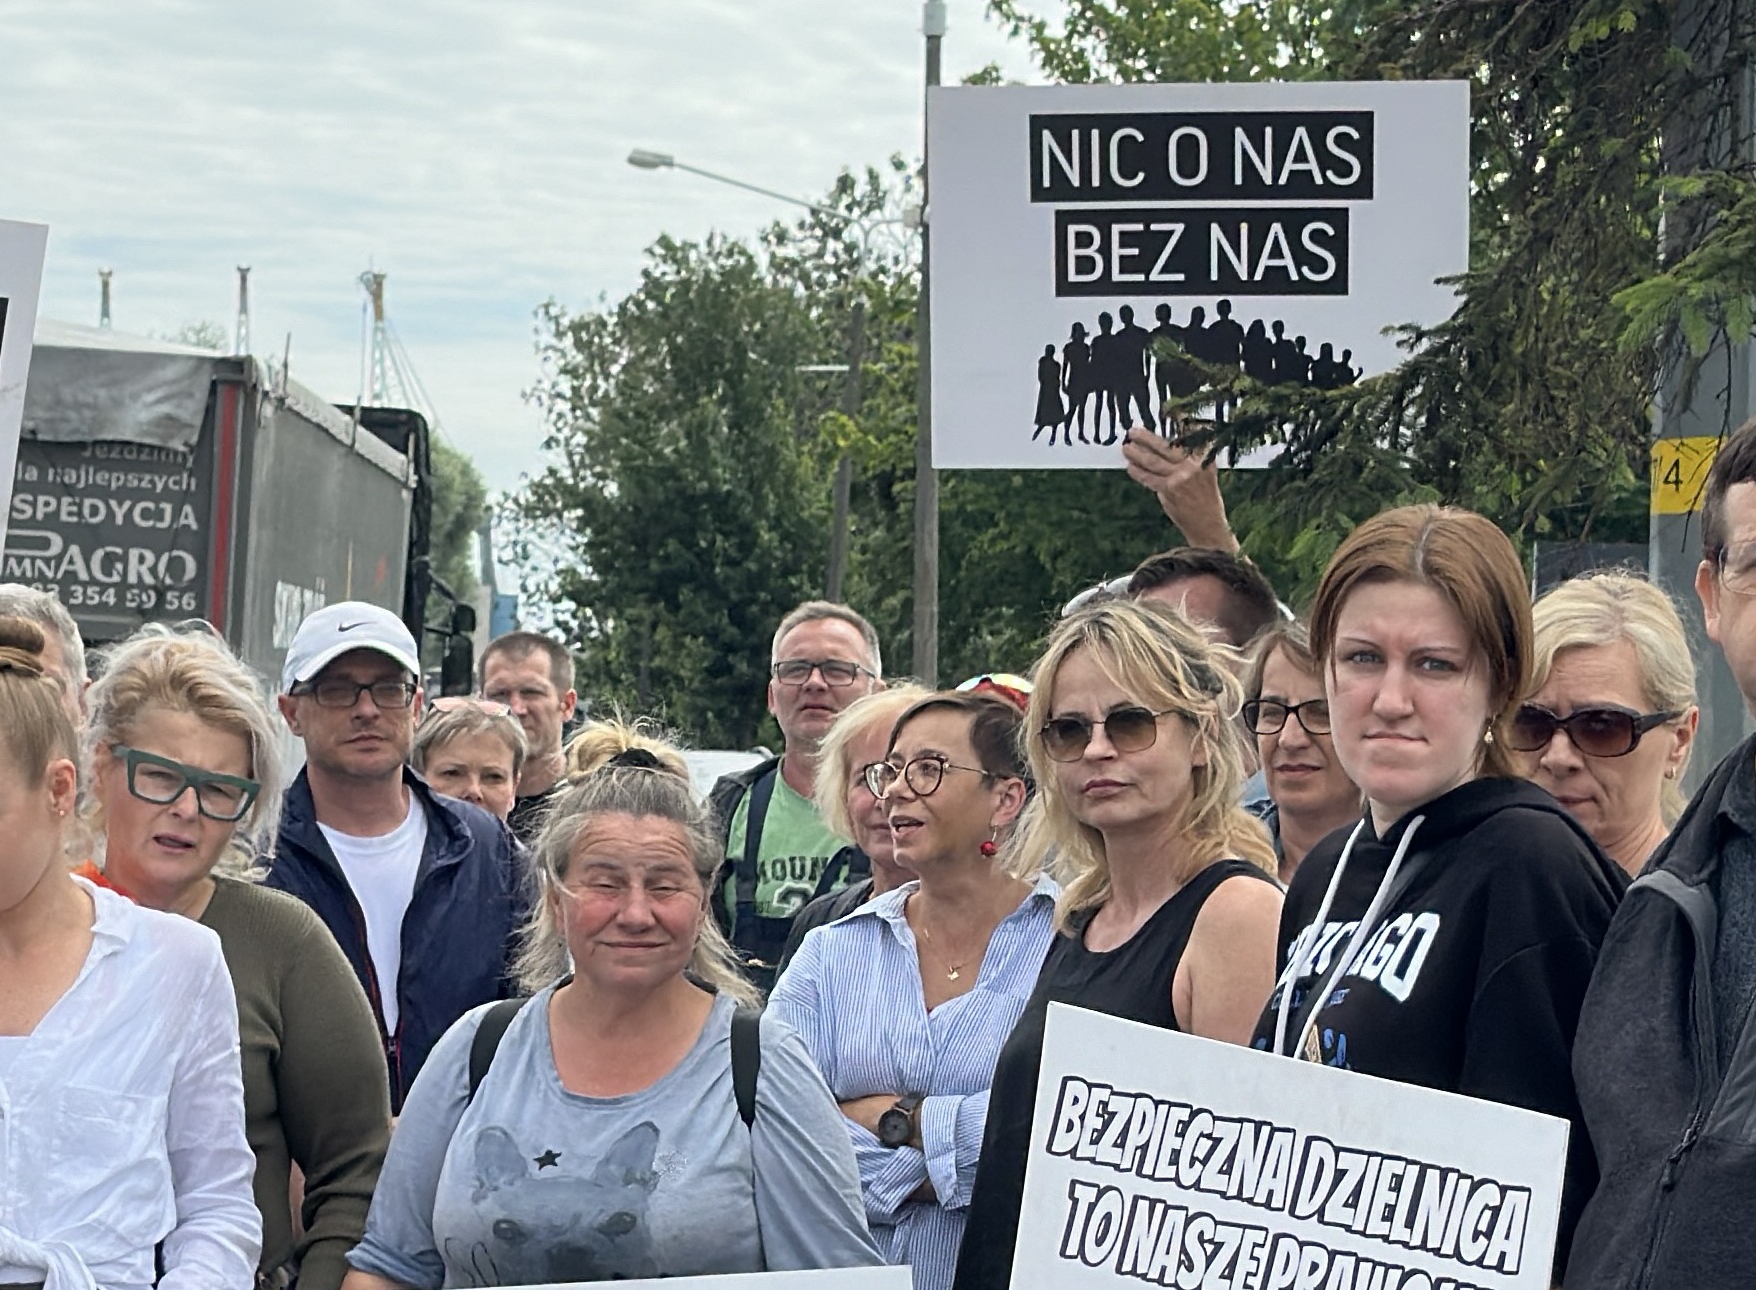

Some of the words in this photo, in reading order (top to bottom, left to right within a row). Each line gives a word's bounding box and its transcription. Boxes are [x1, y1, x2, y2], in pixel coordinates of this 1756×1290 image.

[1040, 127, 1146, 189] NIC
[1167, 126, 1208, 187] O
[1233, 124, 1362, 187] NAS
[1065, 222, 1186, 283] BEZ
[1209, 220, 1337, 282] NAS
[16, 461, 39, 482] la
[47, 463, 196, 494] najlepszych
[11, 492, 199, 531] SPEDYCJA
[68, 585, 117, 607] 354
[125, 588, 157, 609] 59
[165, 592, 197, 611] 56
[757, 855, 830, 885] OUN
[1046, 1076, 1296, 1210] BEZPIECZNA
[1288, 1136, 1532, 1274] DZIELNICA
[1060, 1180, 1124, 1266] TO
